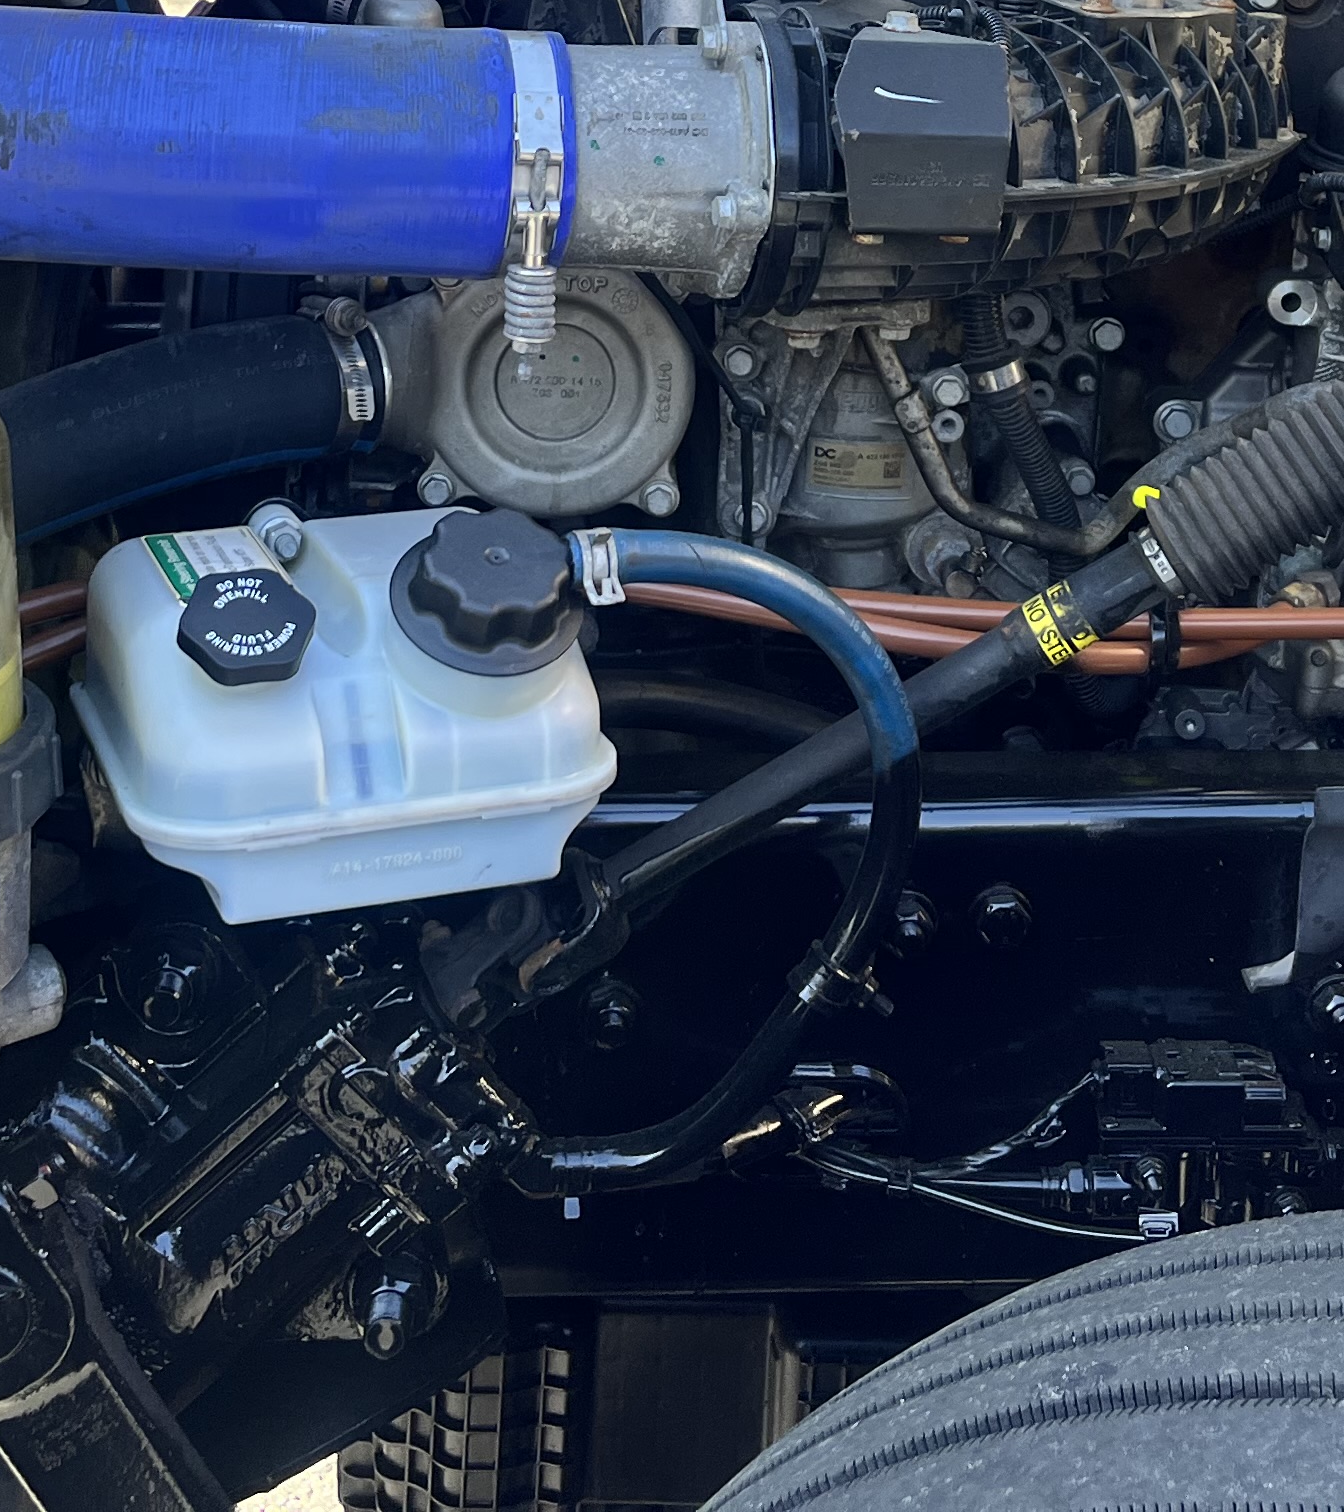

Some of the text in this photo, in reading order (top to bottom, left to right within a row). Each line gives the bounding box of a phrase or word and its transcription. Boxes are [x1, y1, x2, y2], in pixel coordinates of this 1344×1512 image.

[562, 274, 608, 293] TOP
[814, 446, 836, 460] DC
[215, 577, 264, 593] DO NOT
[213, 588, 269, 609] OVERFILL
[1024, 597, 1046, 622] NO
[205, 621, 297, 656] POWER STEERING
[232, 629, 274, 645] FLUID
